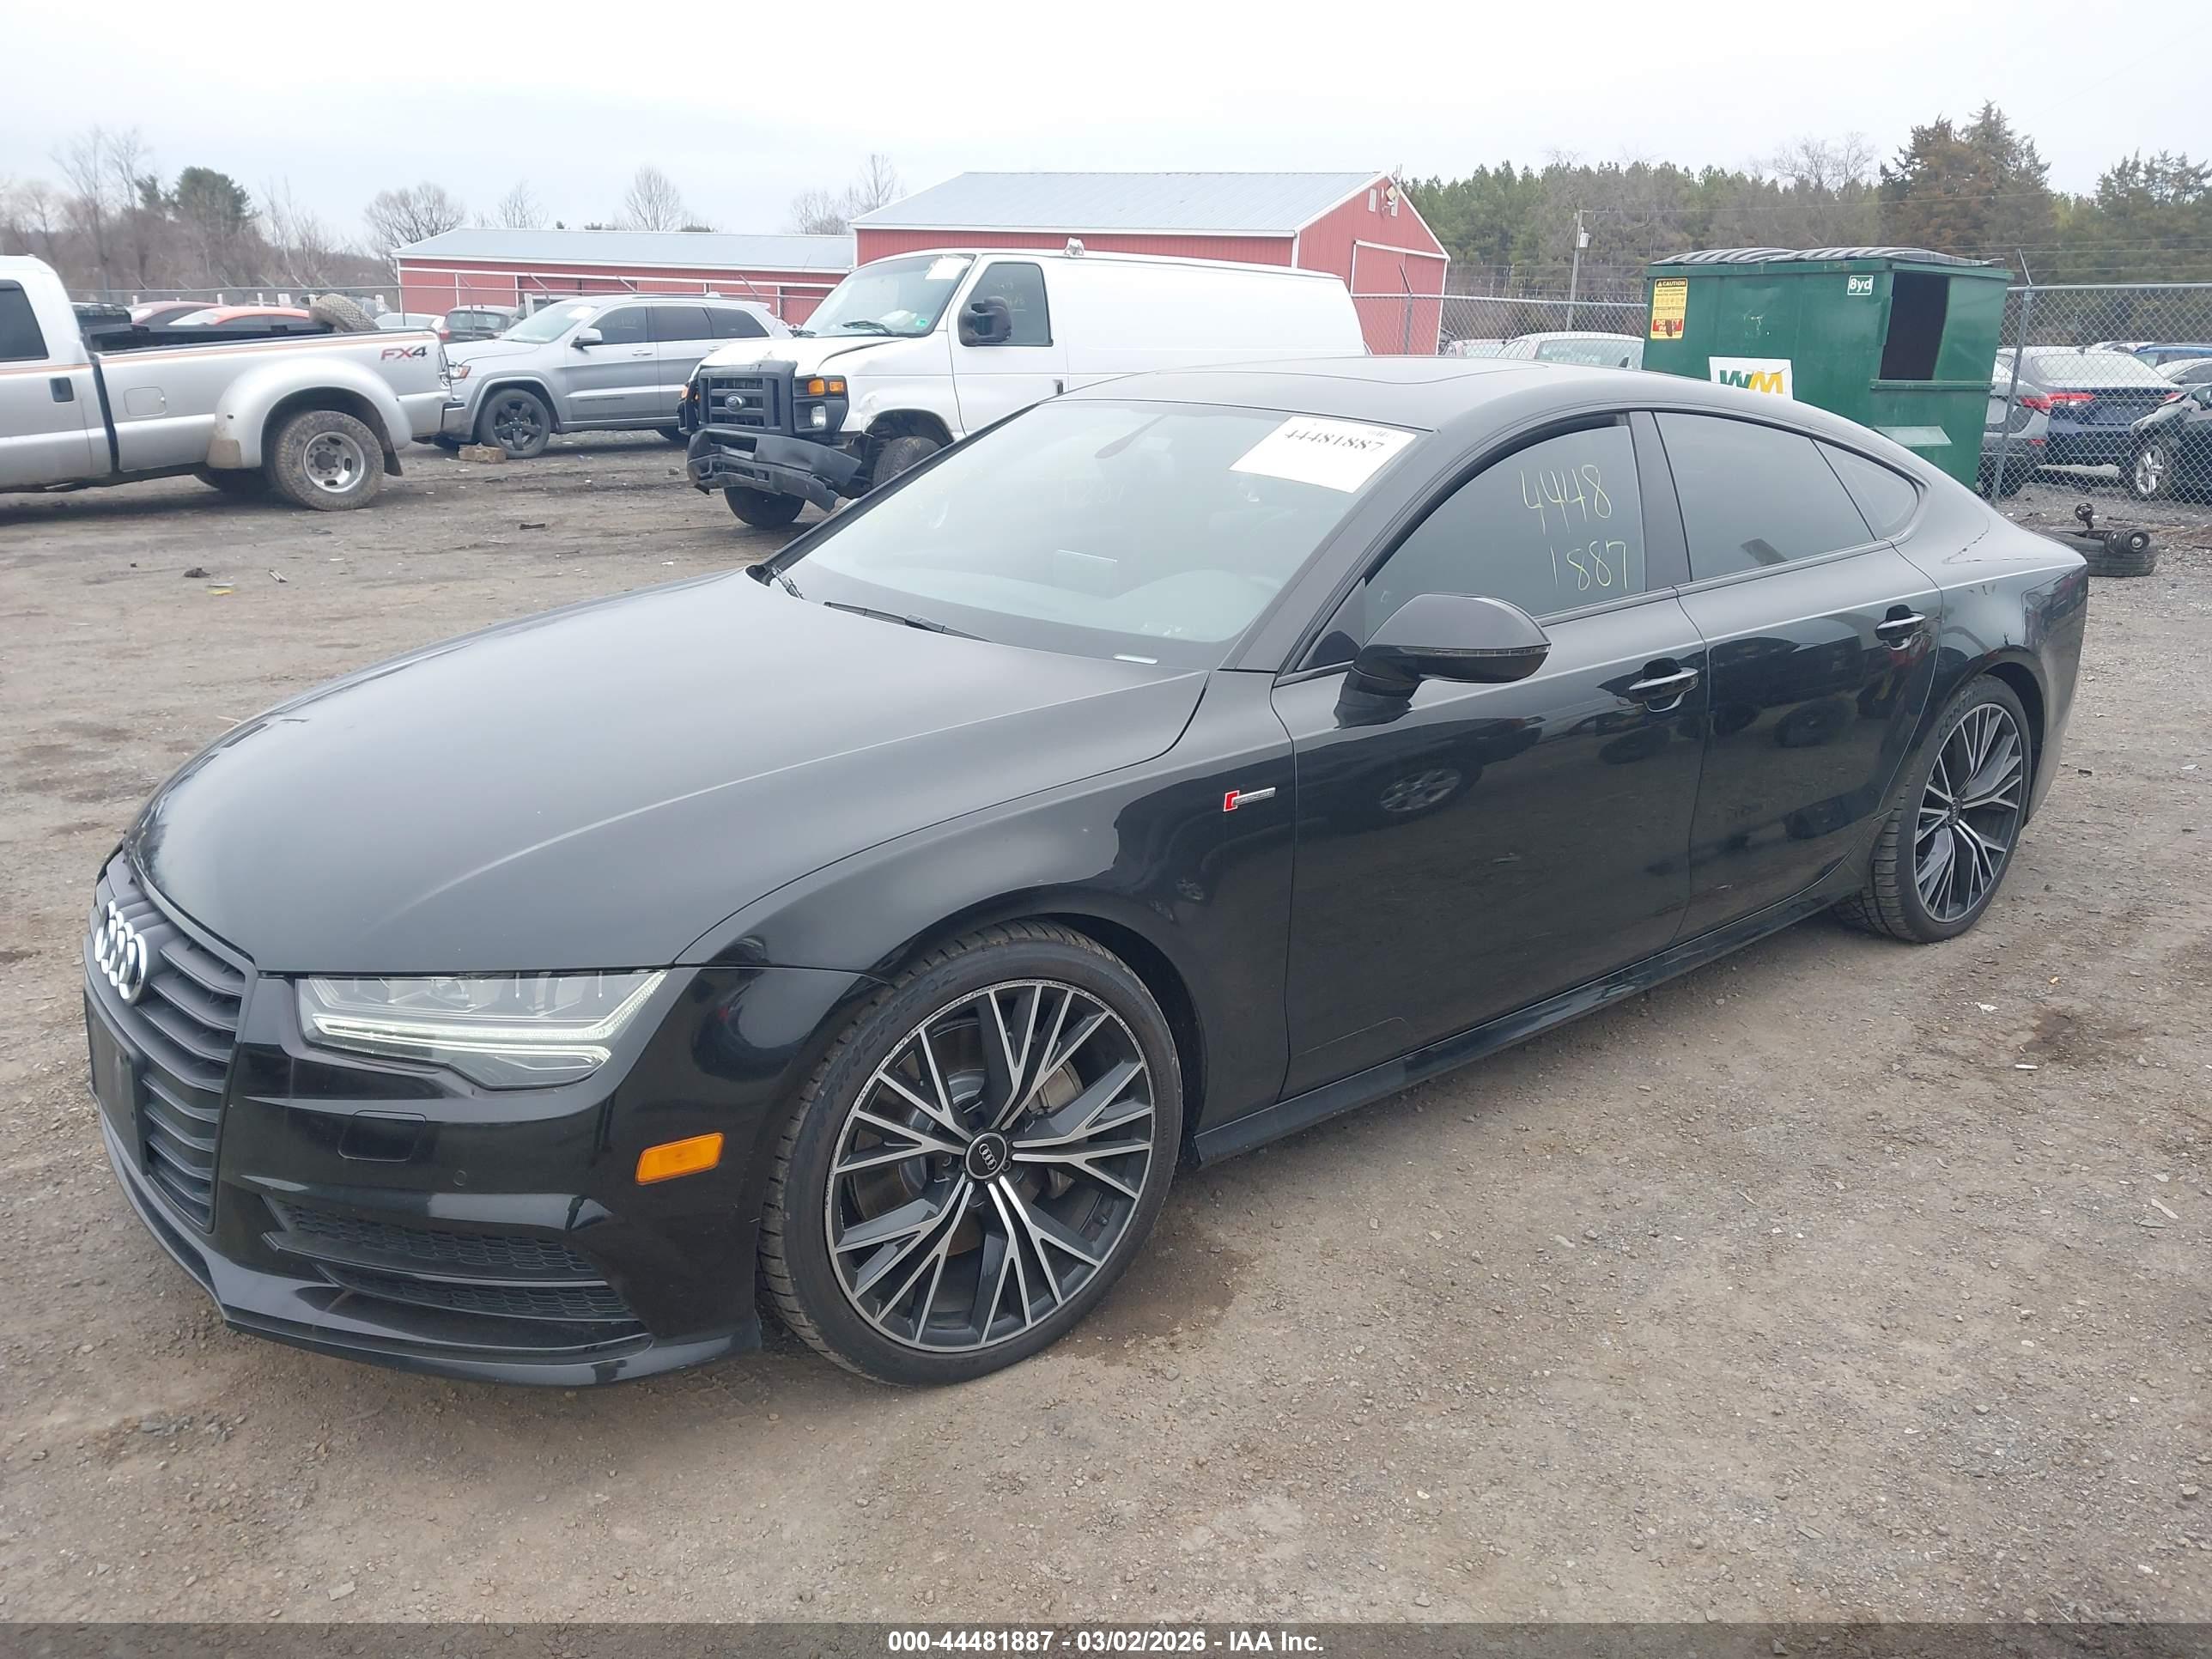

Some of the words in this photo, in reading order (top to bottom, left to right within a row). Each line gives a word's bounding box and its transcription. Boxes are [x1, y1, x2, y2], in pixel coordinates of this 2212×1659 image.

[1850, 277, 1871, 292] 8yd
[380, 346, 428, 361] FX4
[1719, 369, 1784, 395] WM
[1285, 429, 1385, 453] 44481887
[1520, 464, 1613, 535] 4448
[1549, 540, 1628, 591] 1887
